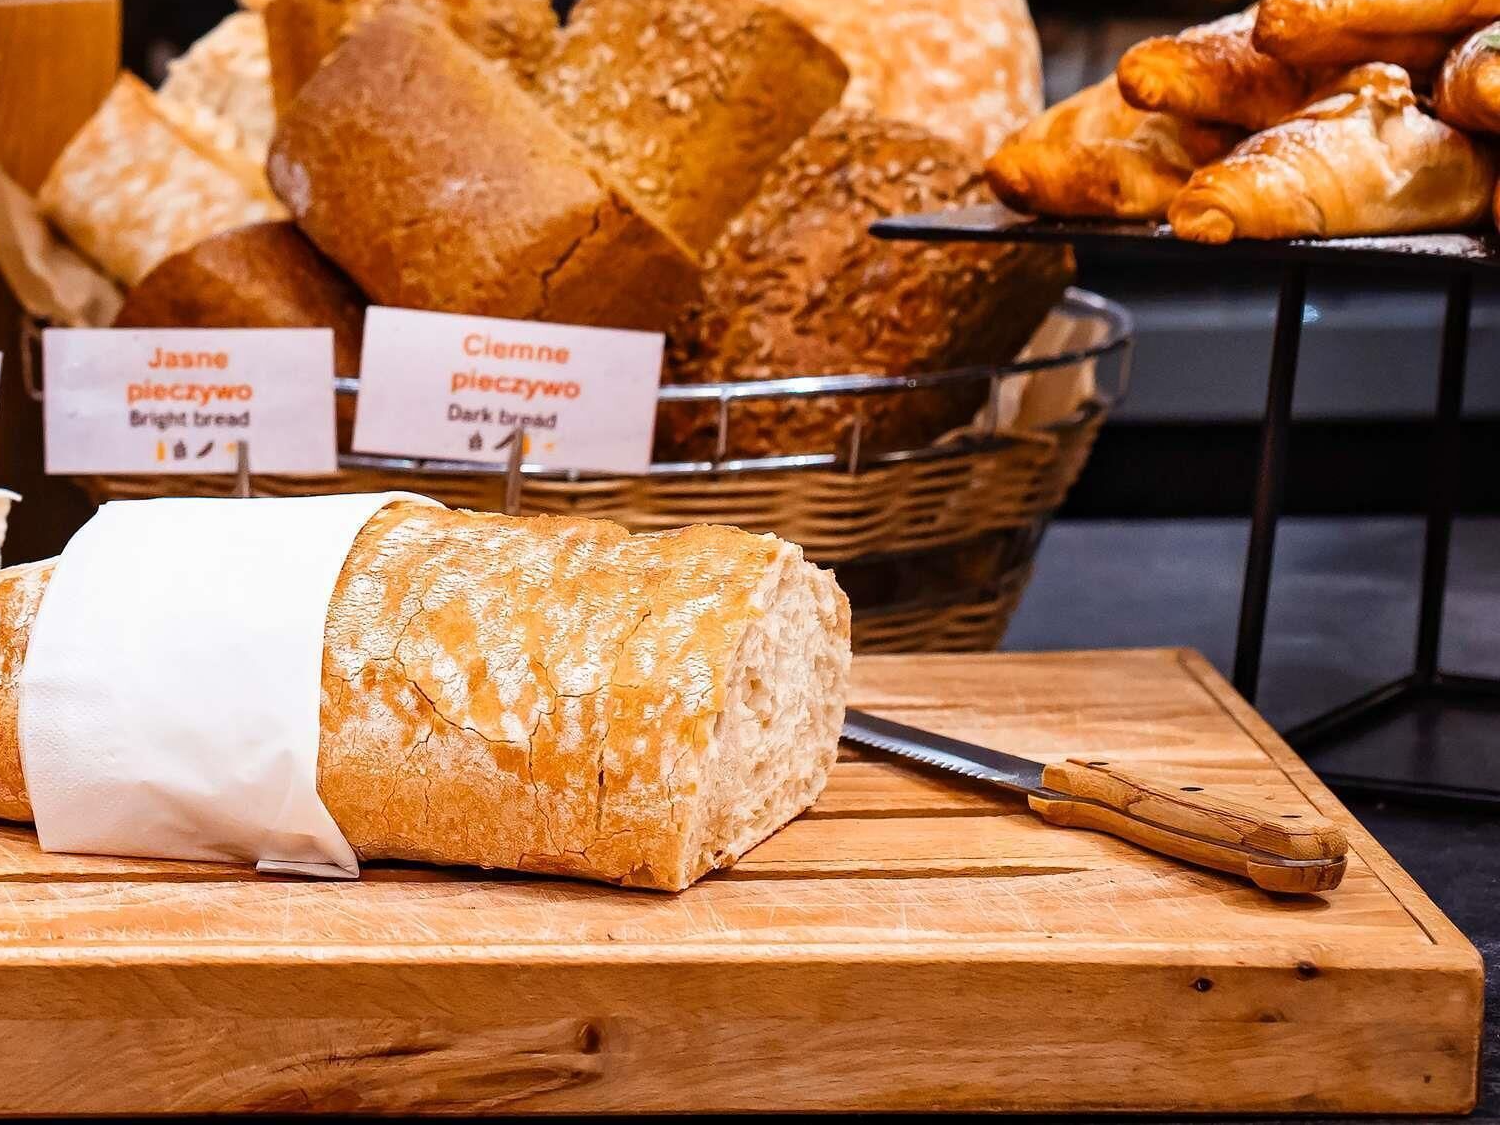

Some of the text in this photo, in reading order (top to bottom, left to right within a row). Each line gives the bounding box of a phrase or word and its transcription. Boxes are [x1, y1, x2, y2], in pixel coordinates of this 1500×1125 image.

[148, 347, 228, 370] Jasne
[462, 333, 571, 364] Ciemne
[126, 378, 253, 405] pieczywo
[451, 371, 581, 400] pieczywo
[130, 409, 251, 430] Bright bread
[447, 403, 557, 429] Dark bread
